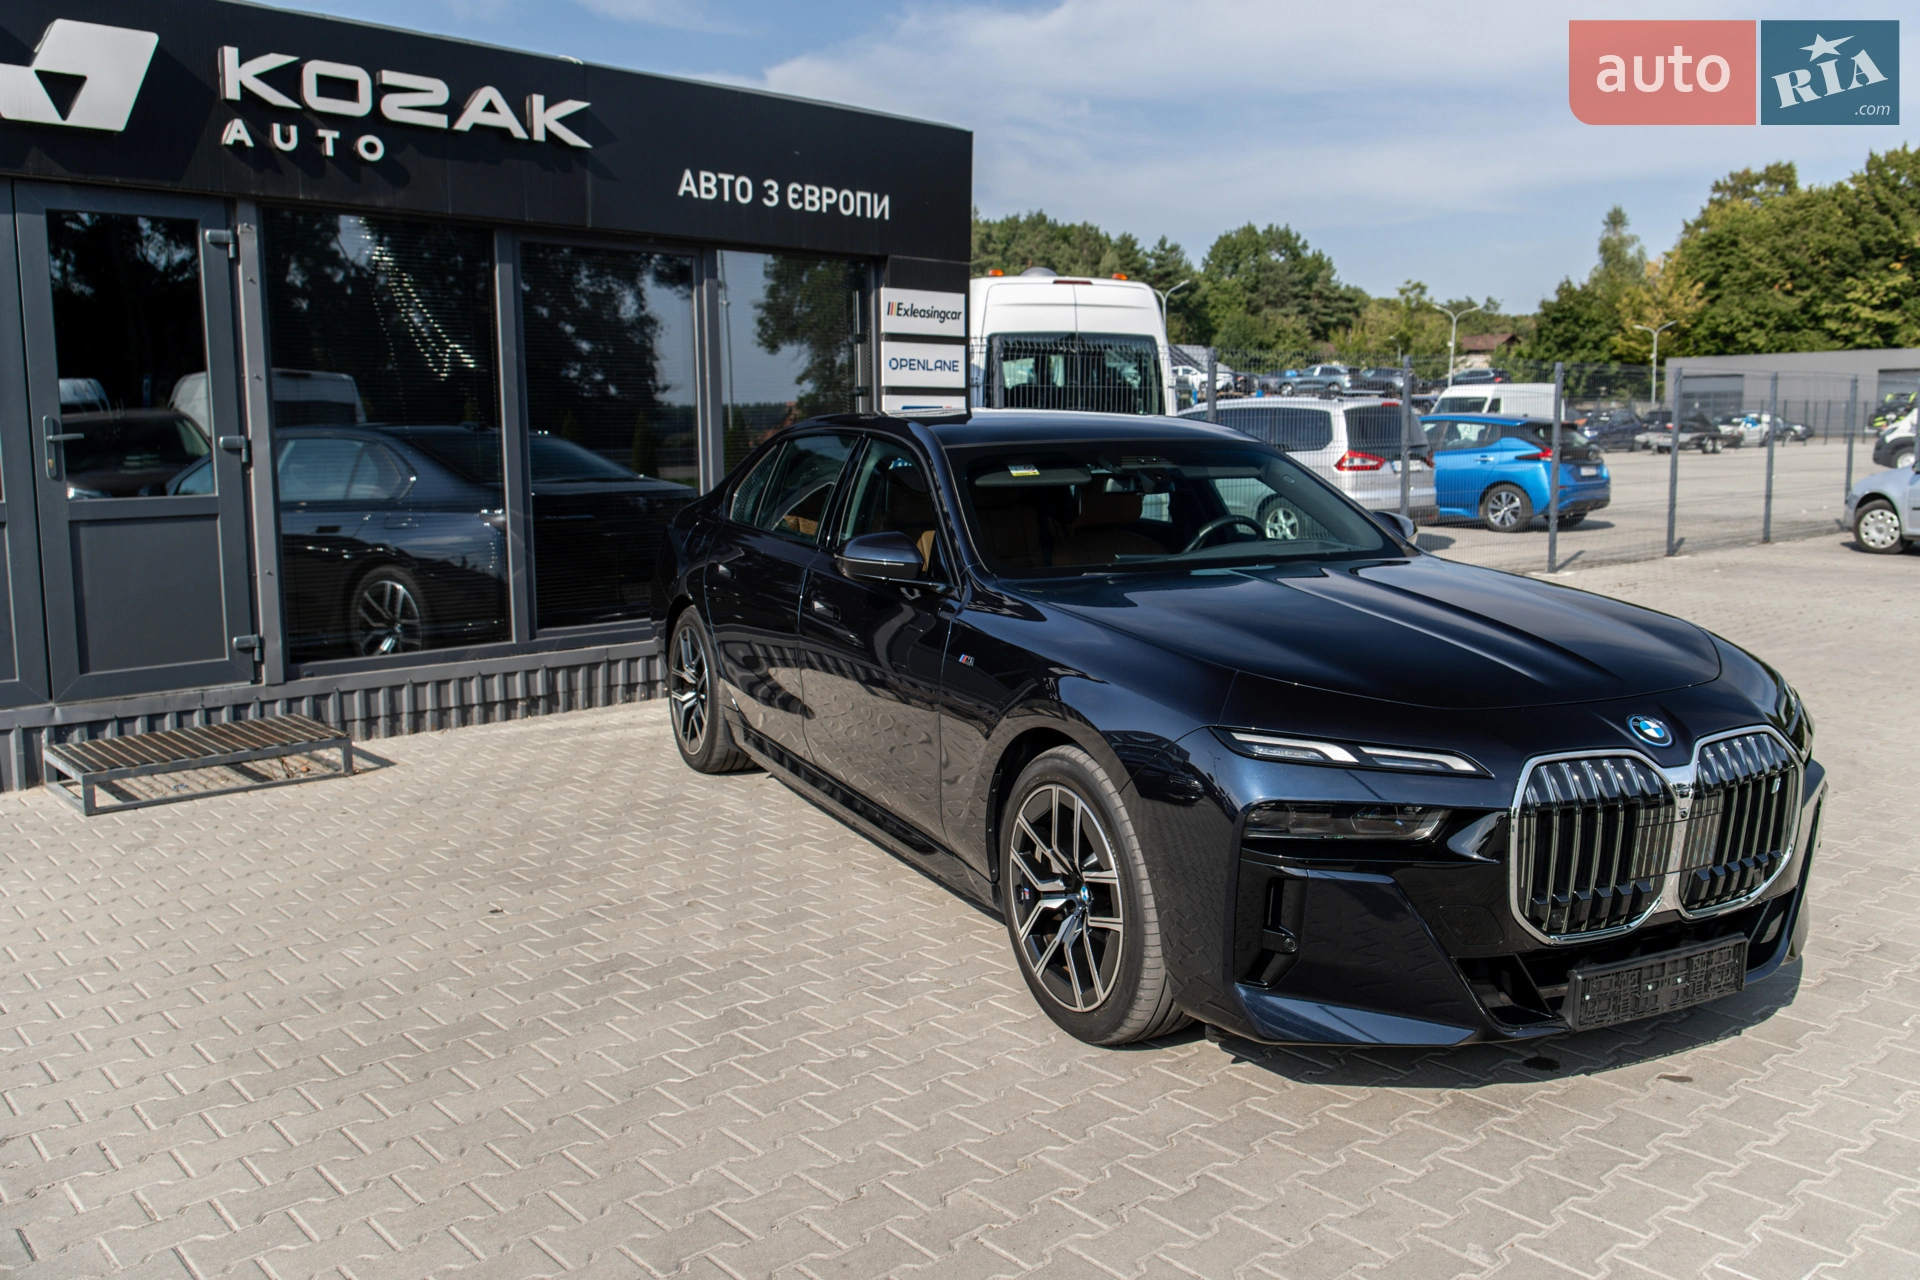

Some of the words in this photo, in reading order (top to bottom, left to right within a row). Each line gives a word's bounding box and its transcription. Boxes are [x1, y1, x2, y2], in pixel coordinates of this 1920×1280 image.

[218, 45, 592, 149] KOZAK
[222, 118, 385, 162] AUTO
[677, 168, 753, 205] АВТО
[762, 179, 779, 207] З
[787, 182, 890, 220] ЄВРОПИ
[896, 302, 962, 323] Exleasingcar
[889, 357, 959, 373] OPENLANE
